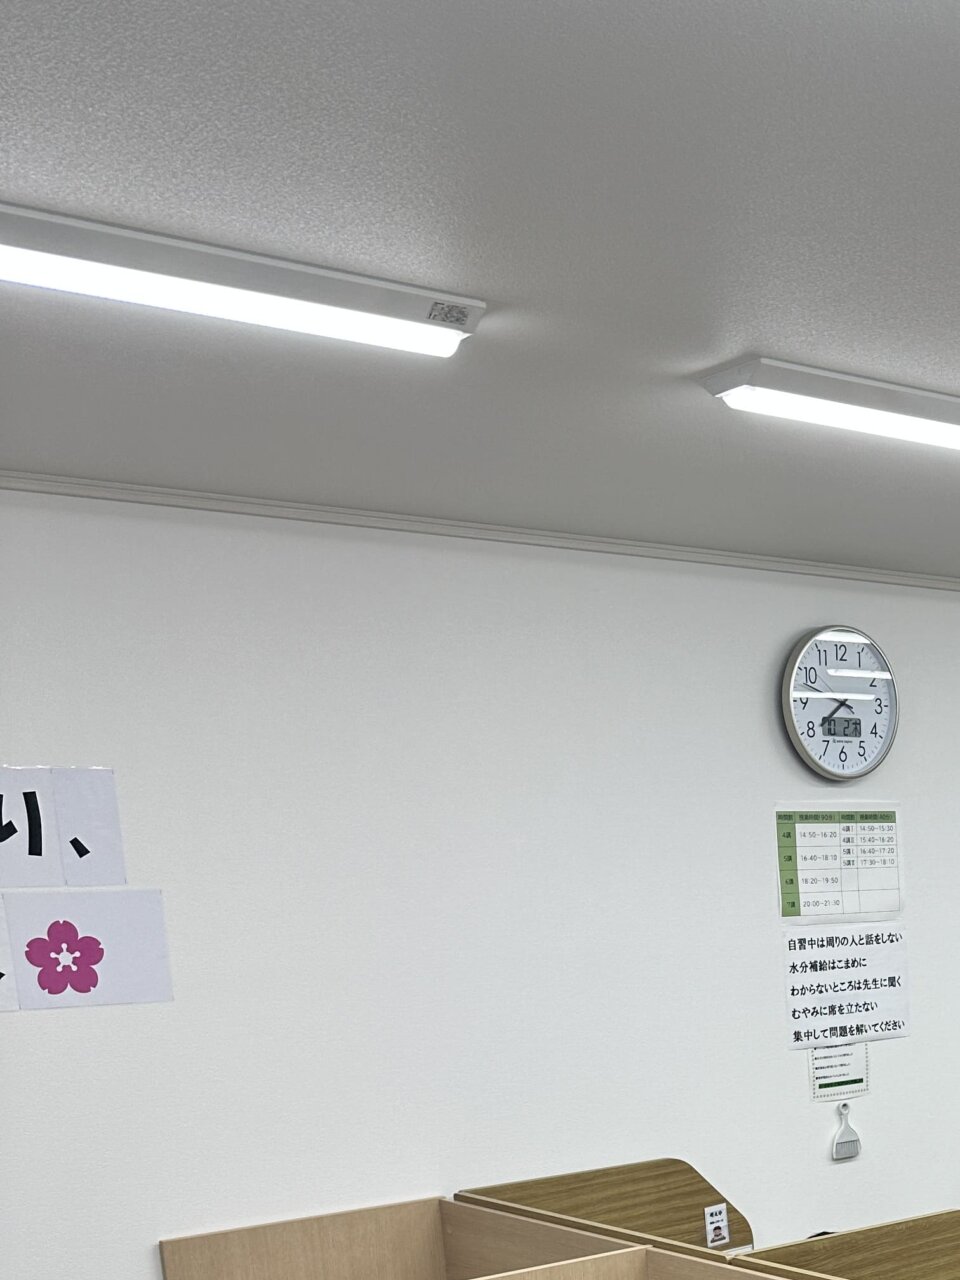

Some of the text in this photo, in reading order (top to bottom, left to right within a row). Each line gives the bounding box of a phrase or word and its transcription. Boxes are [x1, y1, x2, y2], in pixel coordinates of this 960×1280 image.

[817, 649, 828, 666] 11
[834, 643, 847, 661] 12
[856, 651, 862, 668] 1
[803, 666, 817, 684] 10
[874, 698, 883, 714] 3
[806, 721, 816, 738] 8
[869, 722, 878, 738] 4
[822, 740, 830, 756] 7
[838, 746, 848, 762] 6
[857, 741, 866, 757] 5
[788, 932, 903, 951] 自習中は周りの人と話をしない
[789, 957, 867, 974] 水分補給はこまめに
[790, 976, 901, 996] わからないところは先生に聞く
[791, 1001, 878, 1020] むやみに席を立たない
[793, 1020, 905, 1042] 集中して問題を解いてください
